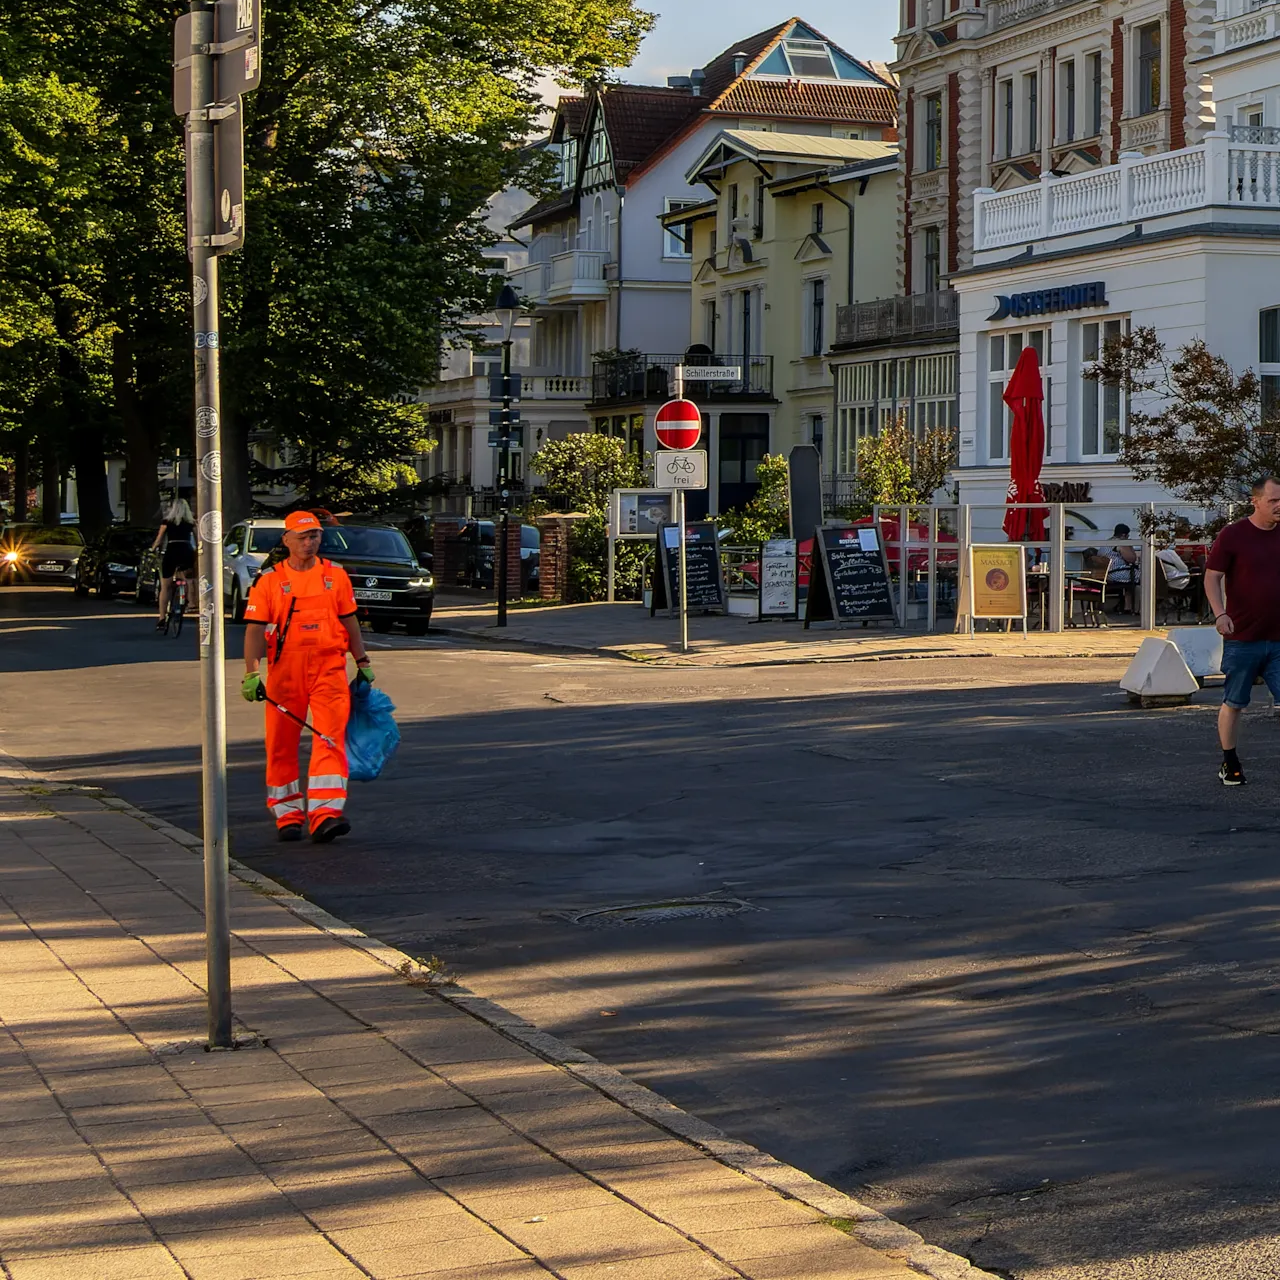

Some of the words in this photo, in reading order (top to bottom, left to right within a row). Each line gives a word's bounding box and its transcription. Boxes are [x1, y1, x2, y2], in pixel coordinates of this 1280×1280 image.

[1011, 281, 1109, 318] OSTSEEHOTEL
[686, 369, 735, 378] Schillerstraße
[673, 475, 690, 484] frei
